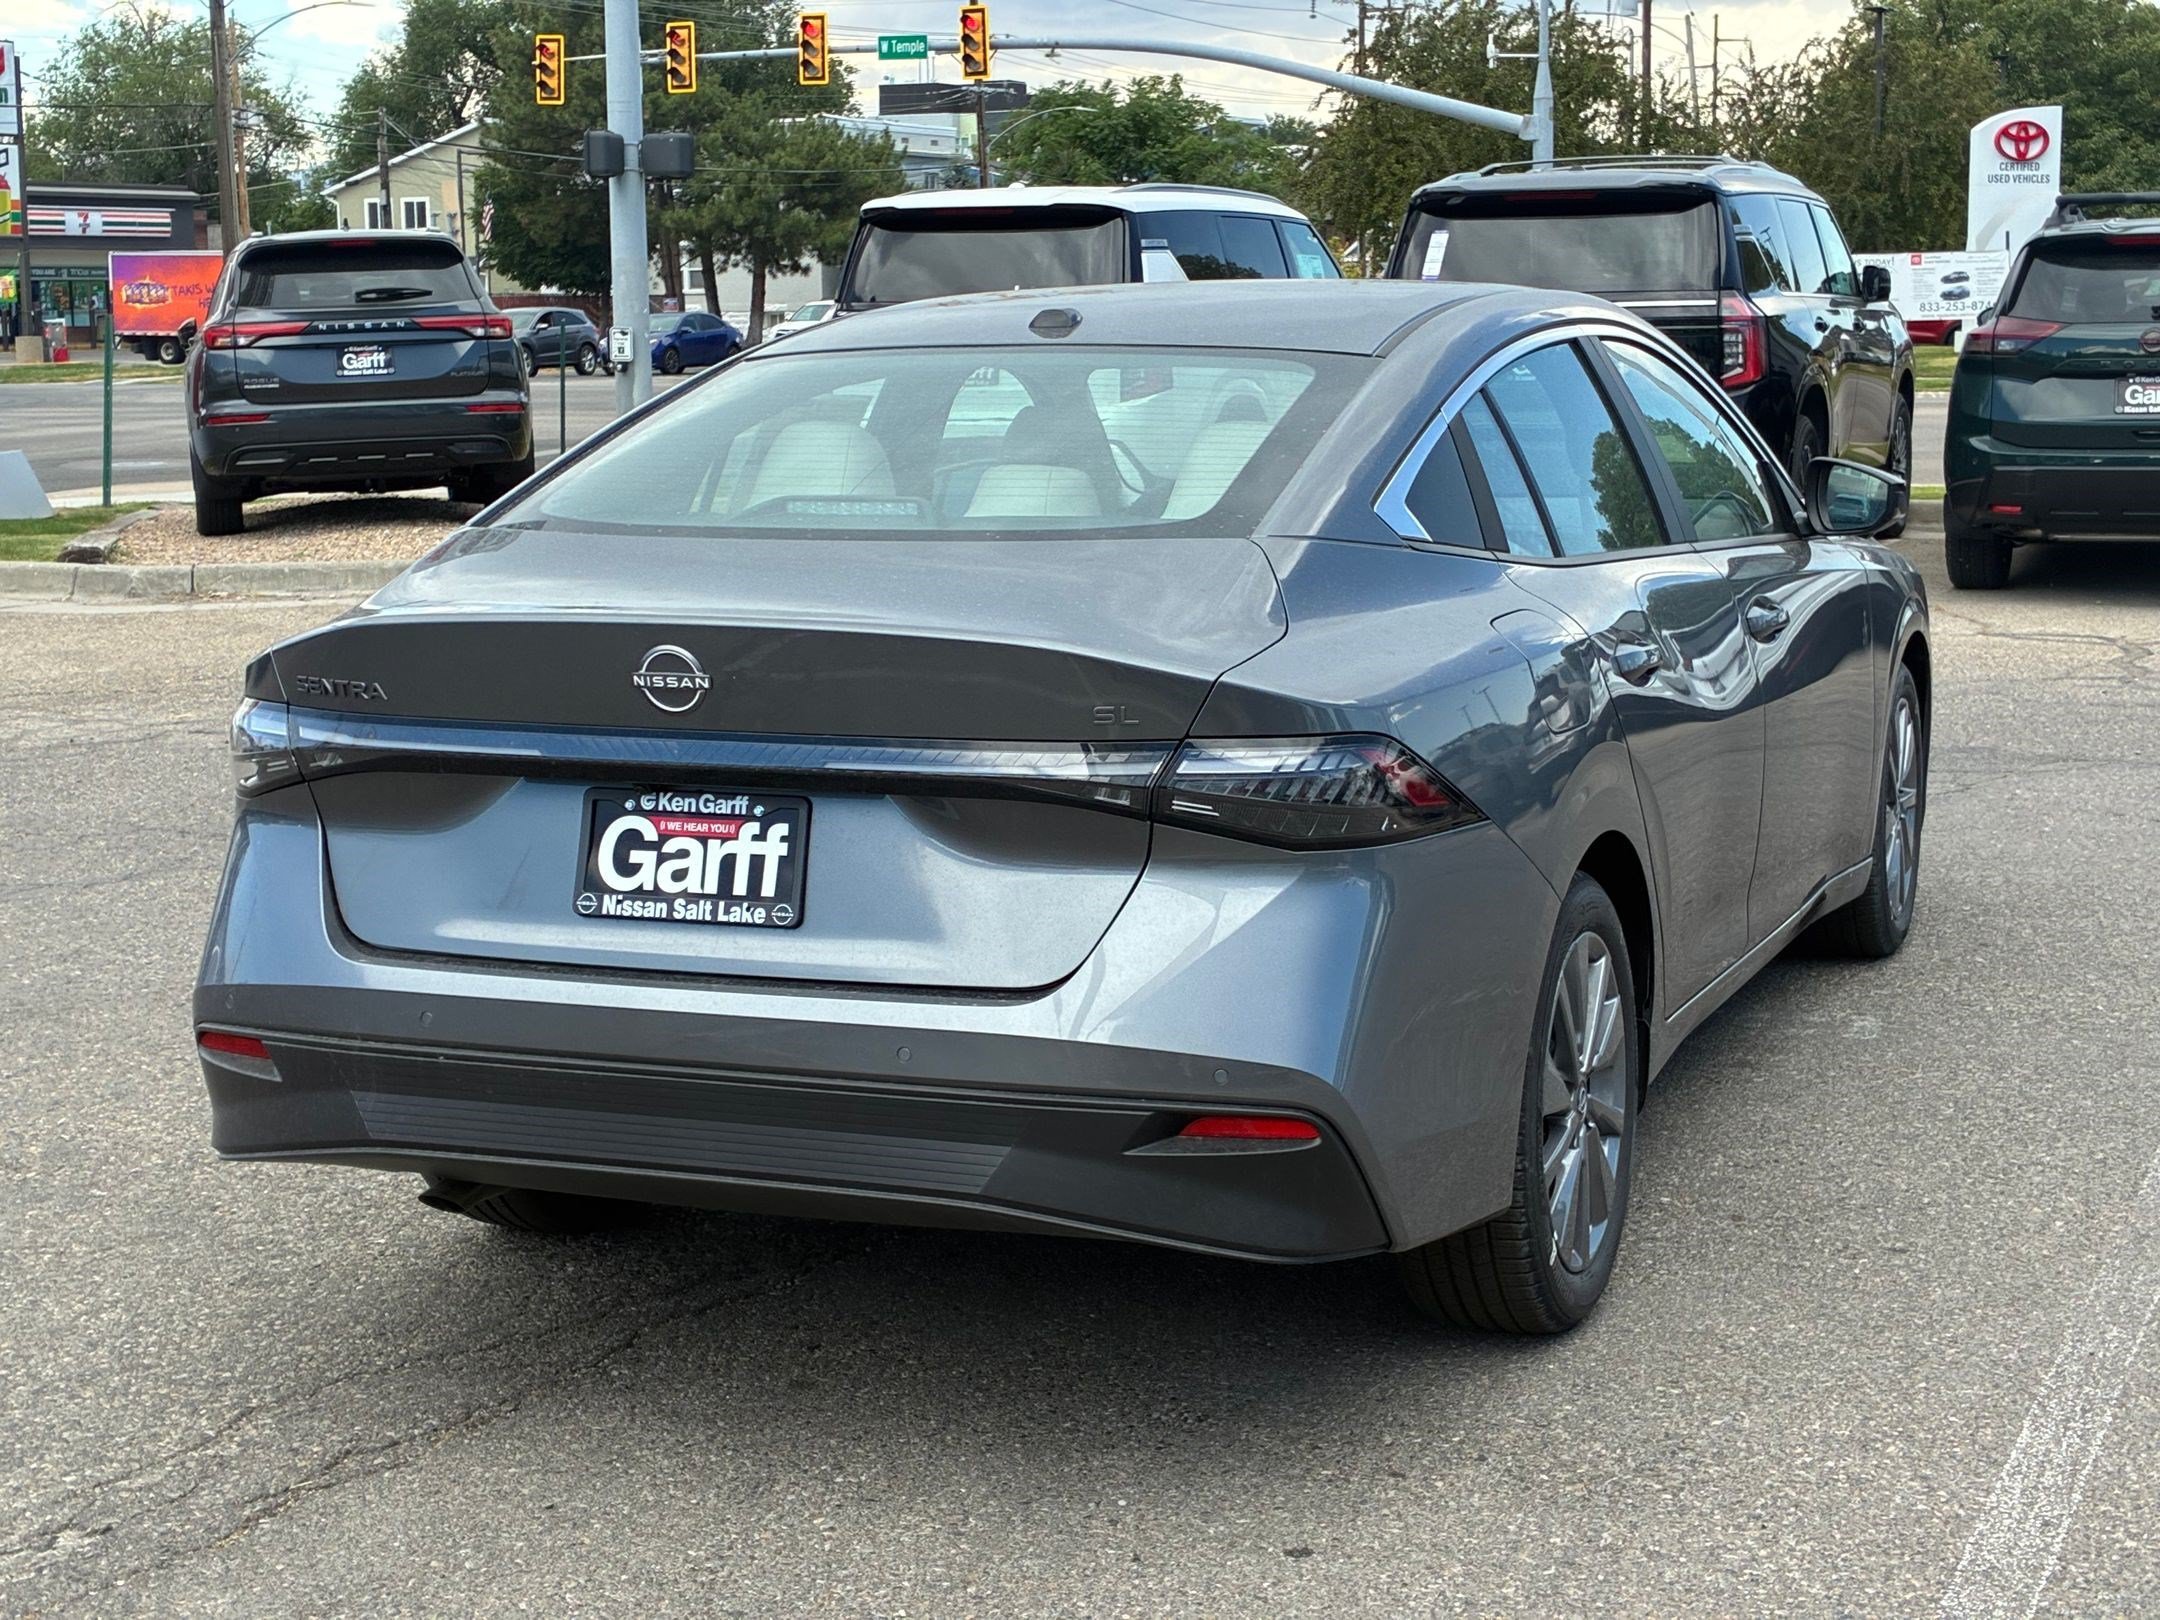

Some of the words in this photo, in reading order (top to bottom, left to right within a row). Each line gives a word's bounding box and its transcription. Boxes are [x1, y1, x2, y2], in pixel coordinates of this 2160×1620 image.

[880, 40, 889, 53] W
[890, 40, 925, 55] Temple
[1999, 161, 2040, 171] CERTIFIED
[1987, 174, 2010, 184] USED
[2012, 174, 2050, 184] VEHICLES
[172, 284, 203, 296] TAKIS
[318, 321, 405, 331] NISSAN
[342, 351, 386, 370] Garff
[295, 674, 388, 701] SENTRA
[632, 674, 710, 689] NISSAN
[1092, 705, 1140, 725] SL
[657, 792, 697, 813] Ken
[698, 794, 750, 816] Garff
[667, 821, 682, 831] WE
[683, 822, 709, 832] HEAR
[710, 824, 729, 834] YOU
[597, 815, 789, 898] Garff
[602, 894, 668, 919] Nissan
[672, 898, 713, 921] Salt
[716, 901, 767, 925] Lake
